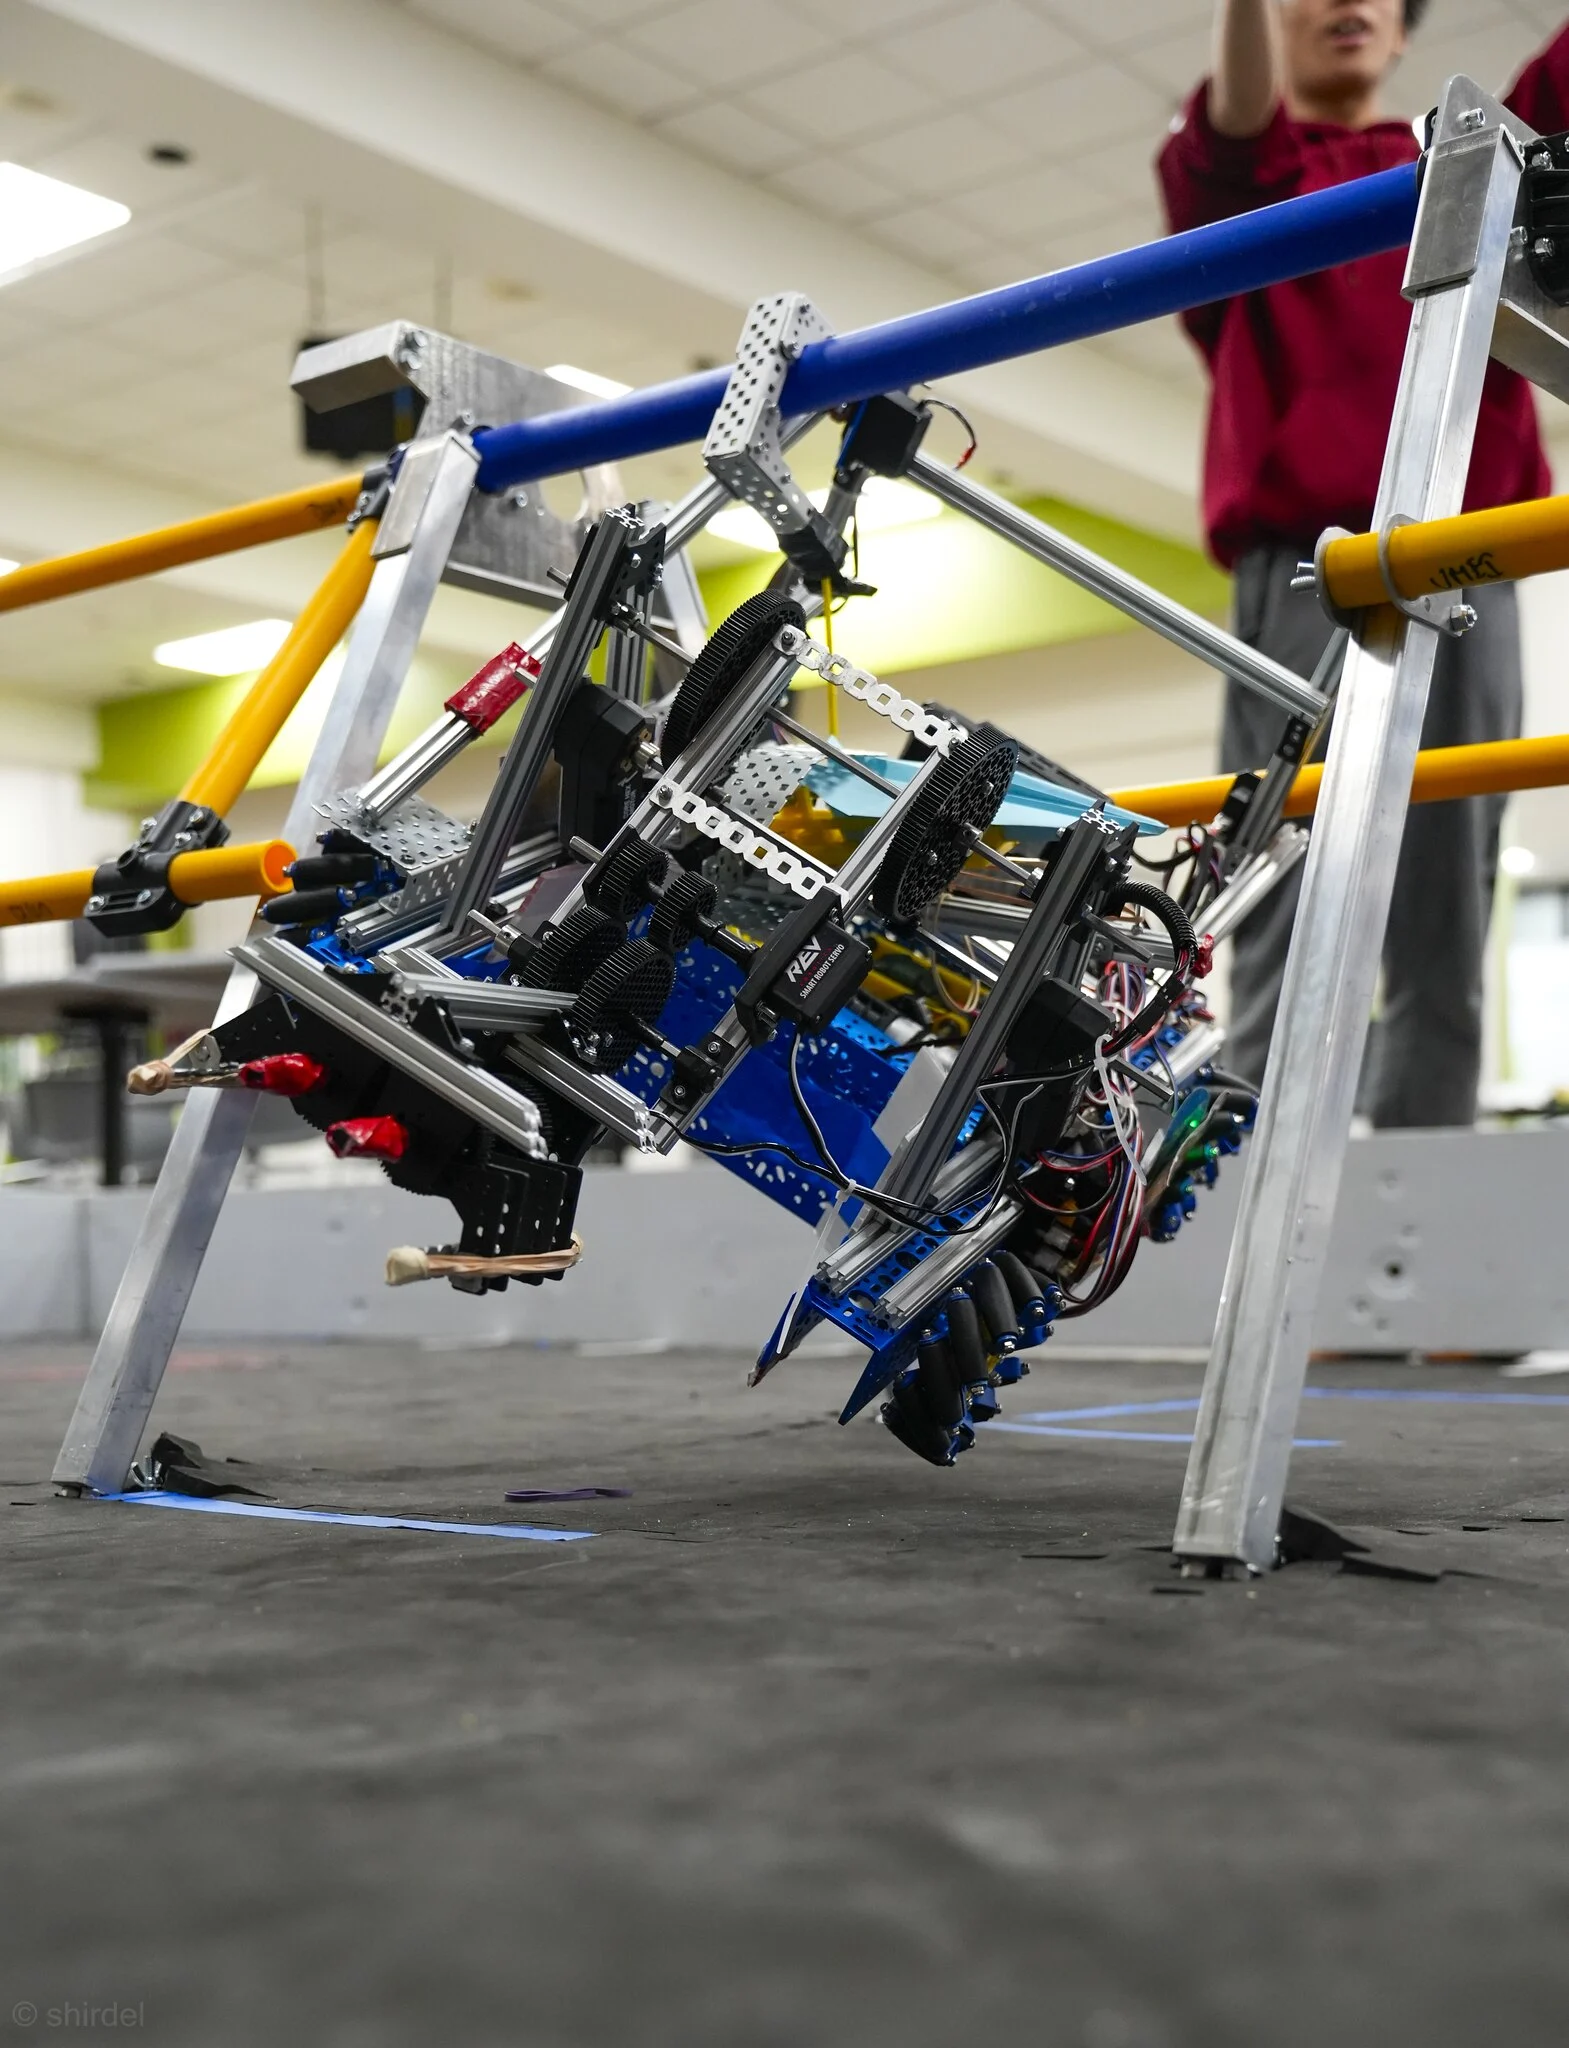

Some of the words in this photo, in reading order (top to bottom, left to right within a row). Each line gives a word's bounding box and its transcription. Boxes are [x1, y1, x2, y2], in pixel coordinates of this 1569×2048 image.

[785, 935, 822, 983] REV
[800, 977, 818, 999] SMART
[814, 960, 832, 980] ROBOT
[828, 943, 845, 964] SERVO
